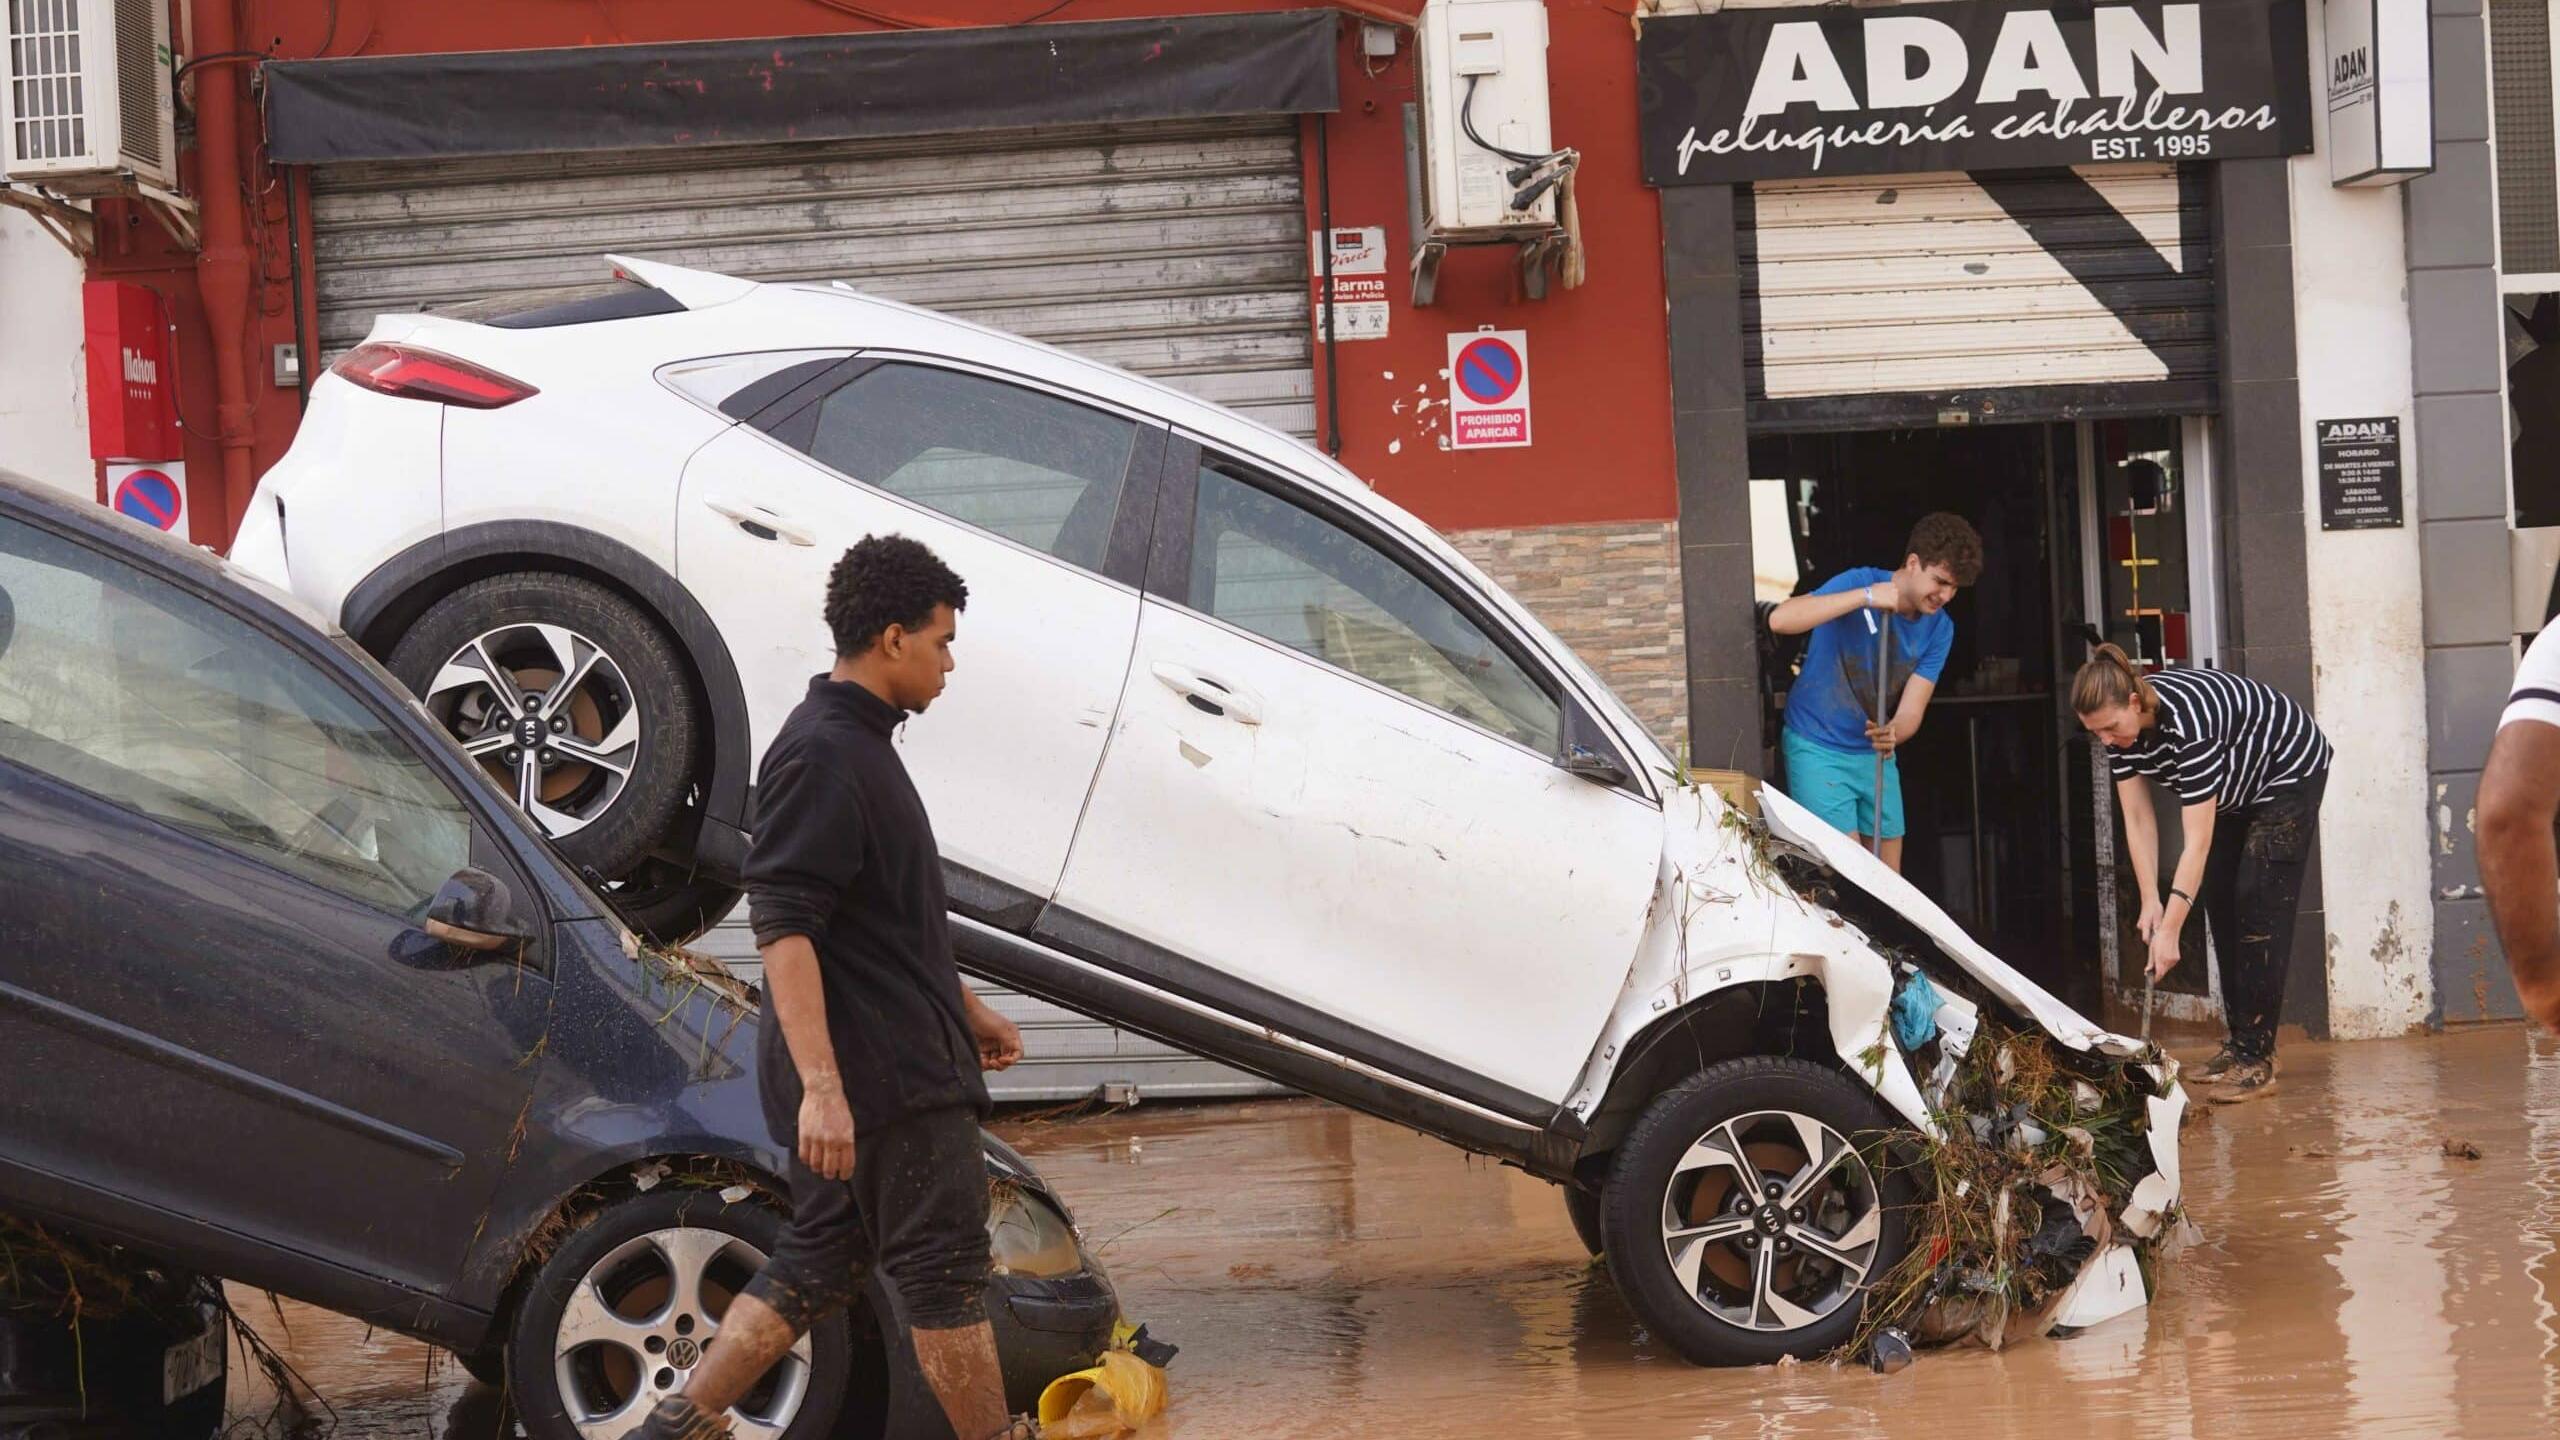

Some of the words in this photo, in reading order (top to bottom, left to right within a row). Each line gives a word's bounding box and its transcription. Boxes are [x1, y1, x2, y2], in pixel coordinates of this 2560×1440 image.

[1744, 5, 2204, 116] ADAN
[2334, 46, 2367, 87] ADAN
[1678, 106, 1974, 174] peluquería
[1992, 86, 2277, 136] caballeros
[2091, 138, 2147, 160] EST.
[2154, 134, 2211, 158] 1995
[1319, 277, 1385, 293] larma
[123, 347, 157, 385] Mahou
[1460, 413, 1522, 426] PROHIBIDO
[2328, 423, 2386, 437] ADAN
[1466, 427, 1517, 439] APARCAR
[2338, 449, 2379, 457] HORARIO
[525, 721, 536, 745] KIA
[1763, 1208, 1780, 1232] KIA
